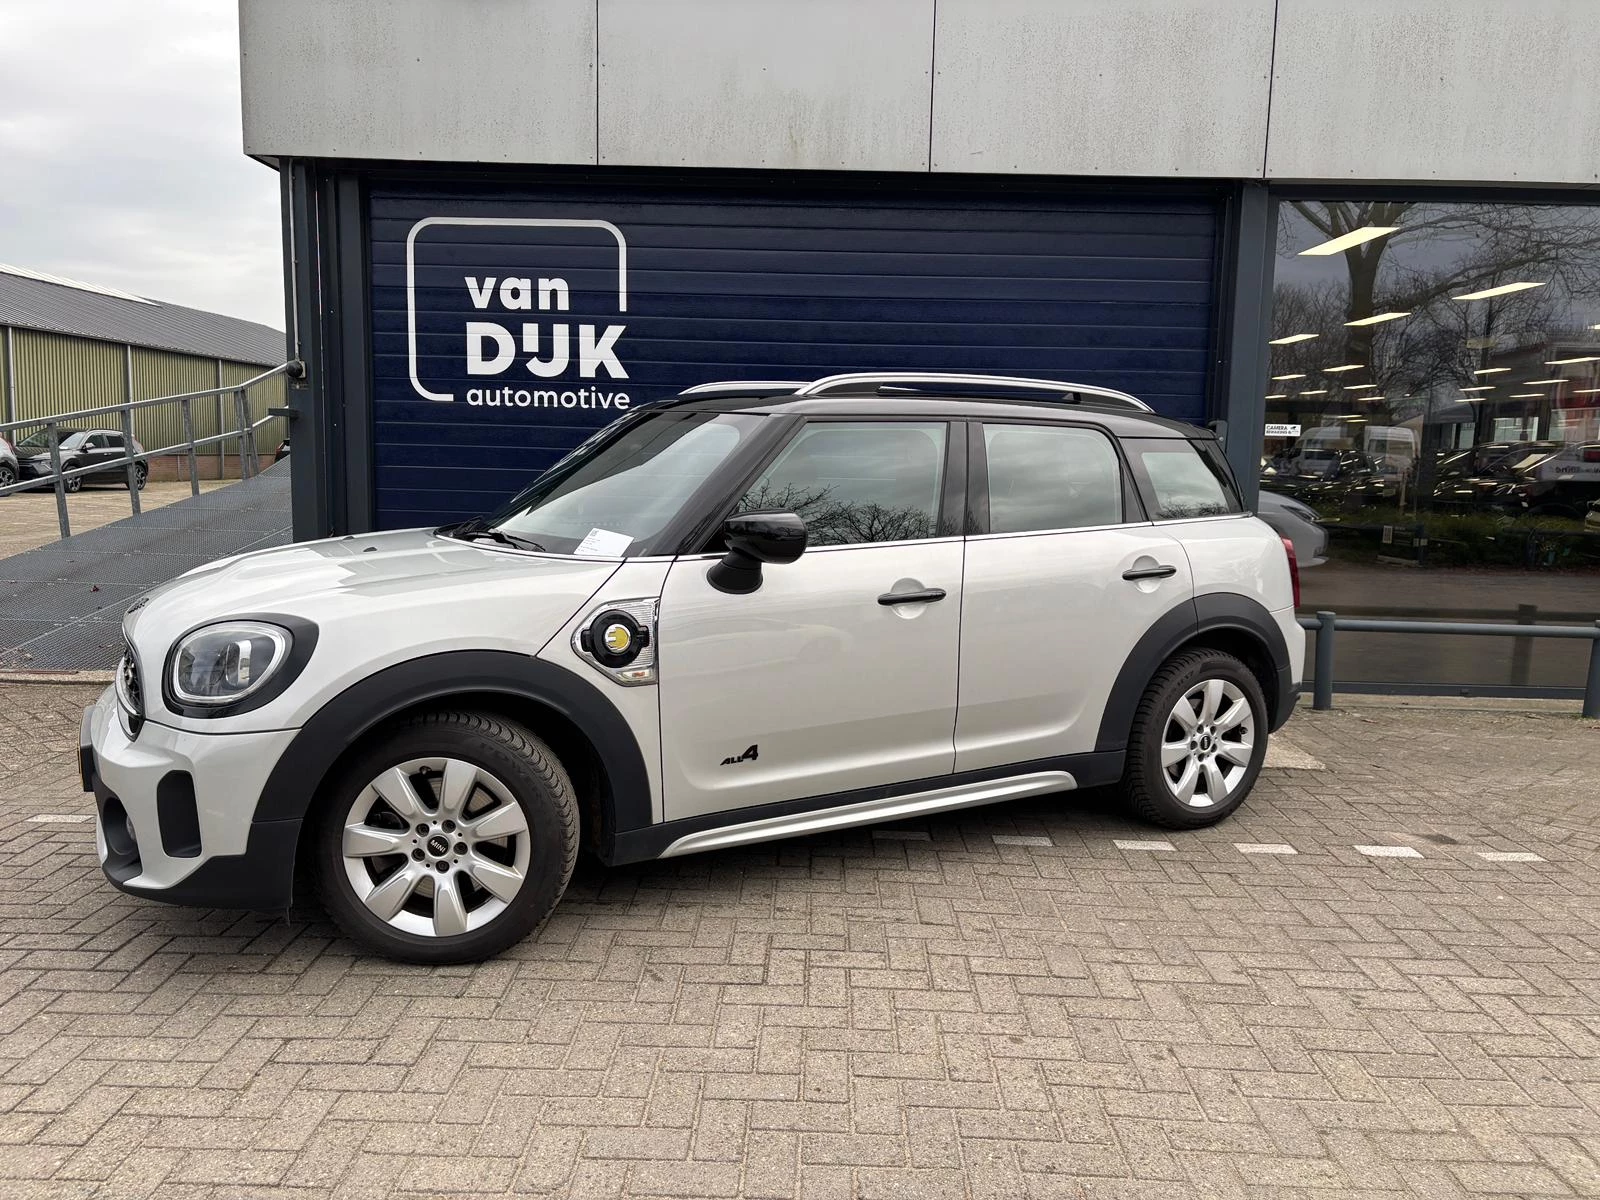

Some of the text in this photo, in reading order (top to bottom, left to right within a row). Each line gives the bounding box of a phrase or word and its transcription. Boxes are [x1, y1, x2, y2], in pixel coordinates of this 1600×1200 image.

[464, 277, 569, 310] van
[466, 387, 630, 409] automotive
[720, 744, 758, 766] ALL4
[430, 839, 446, 853] MINI
